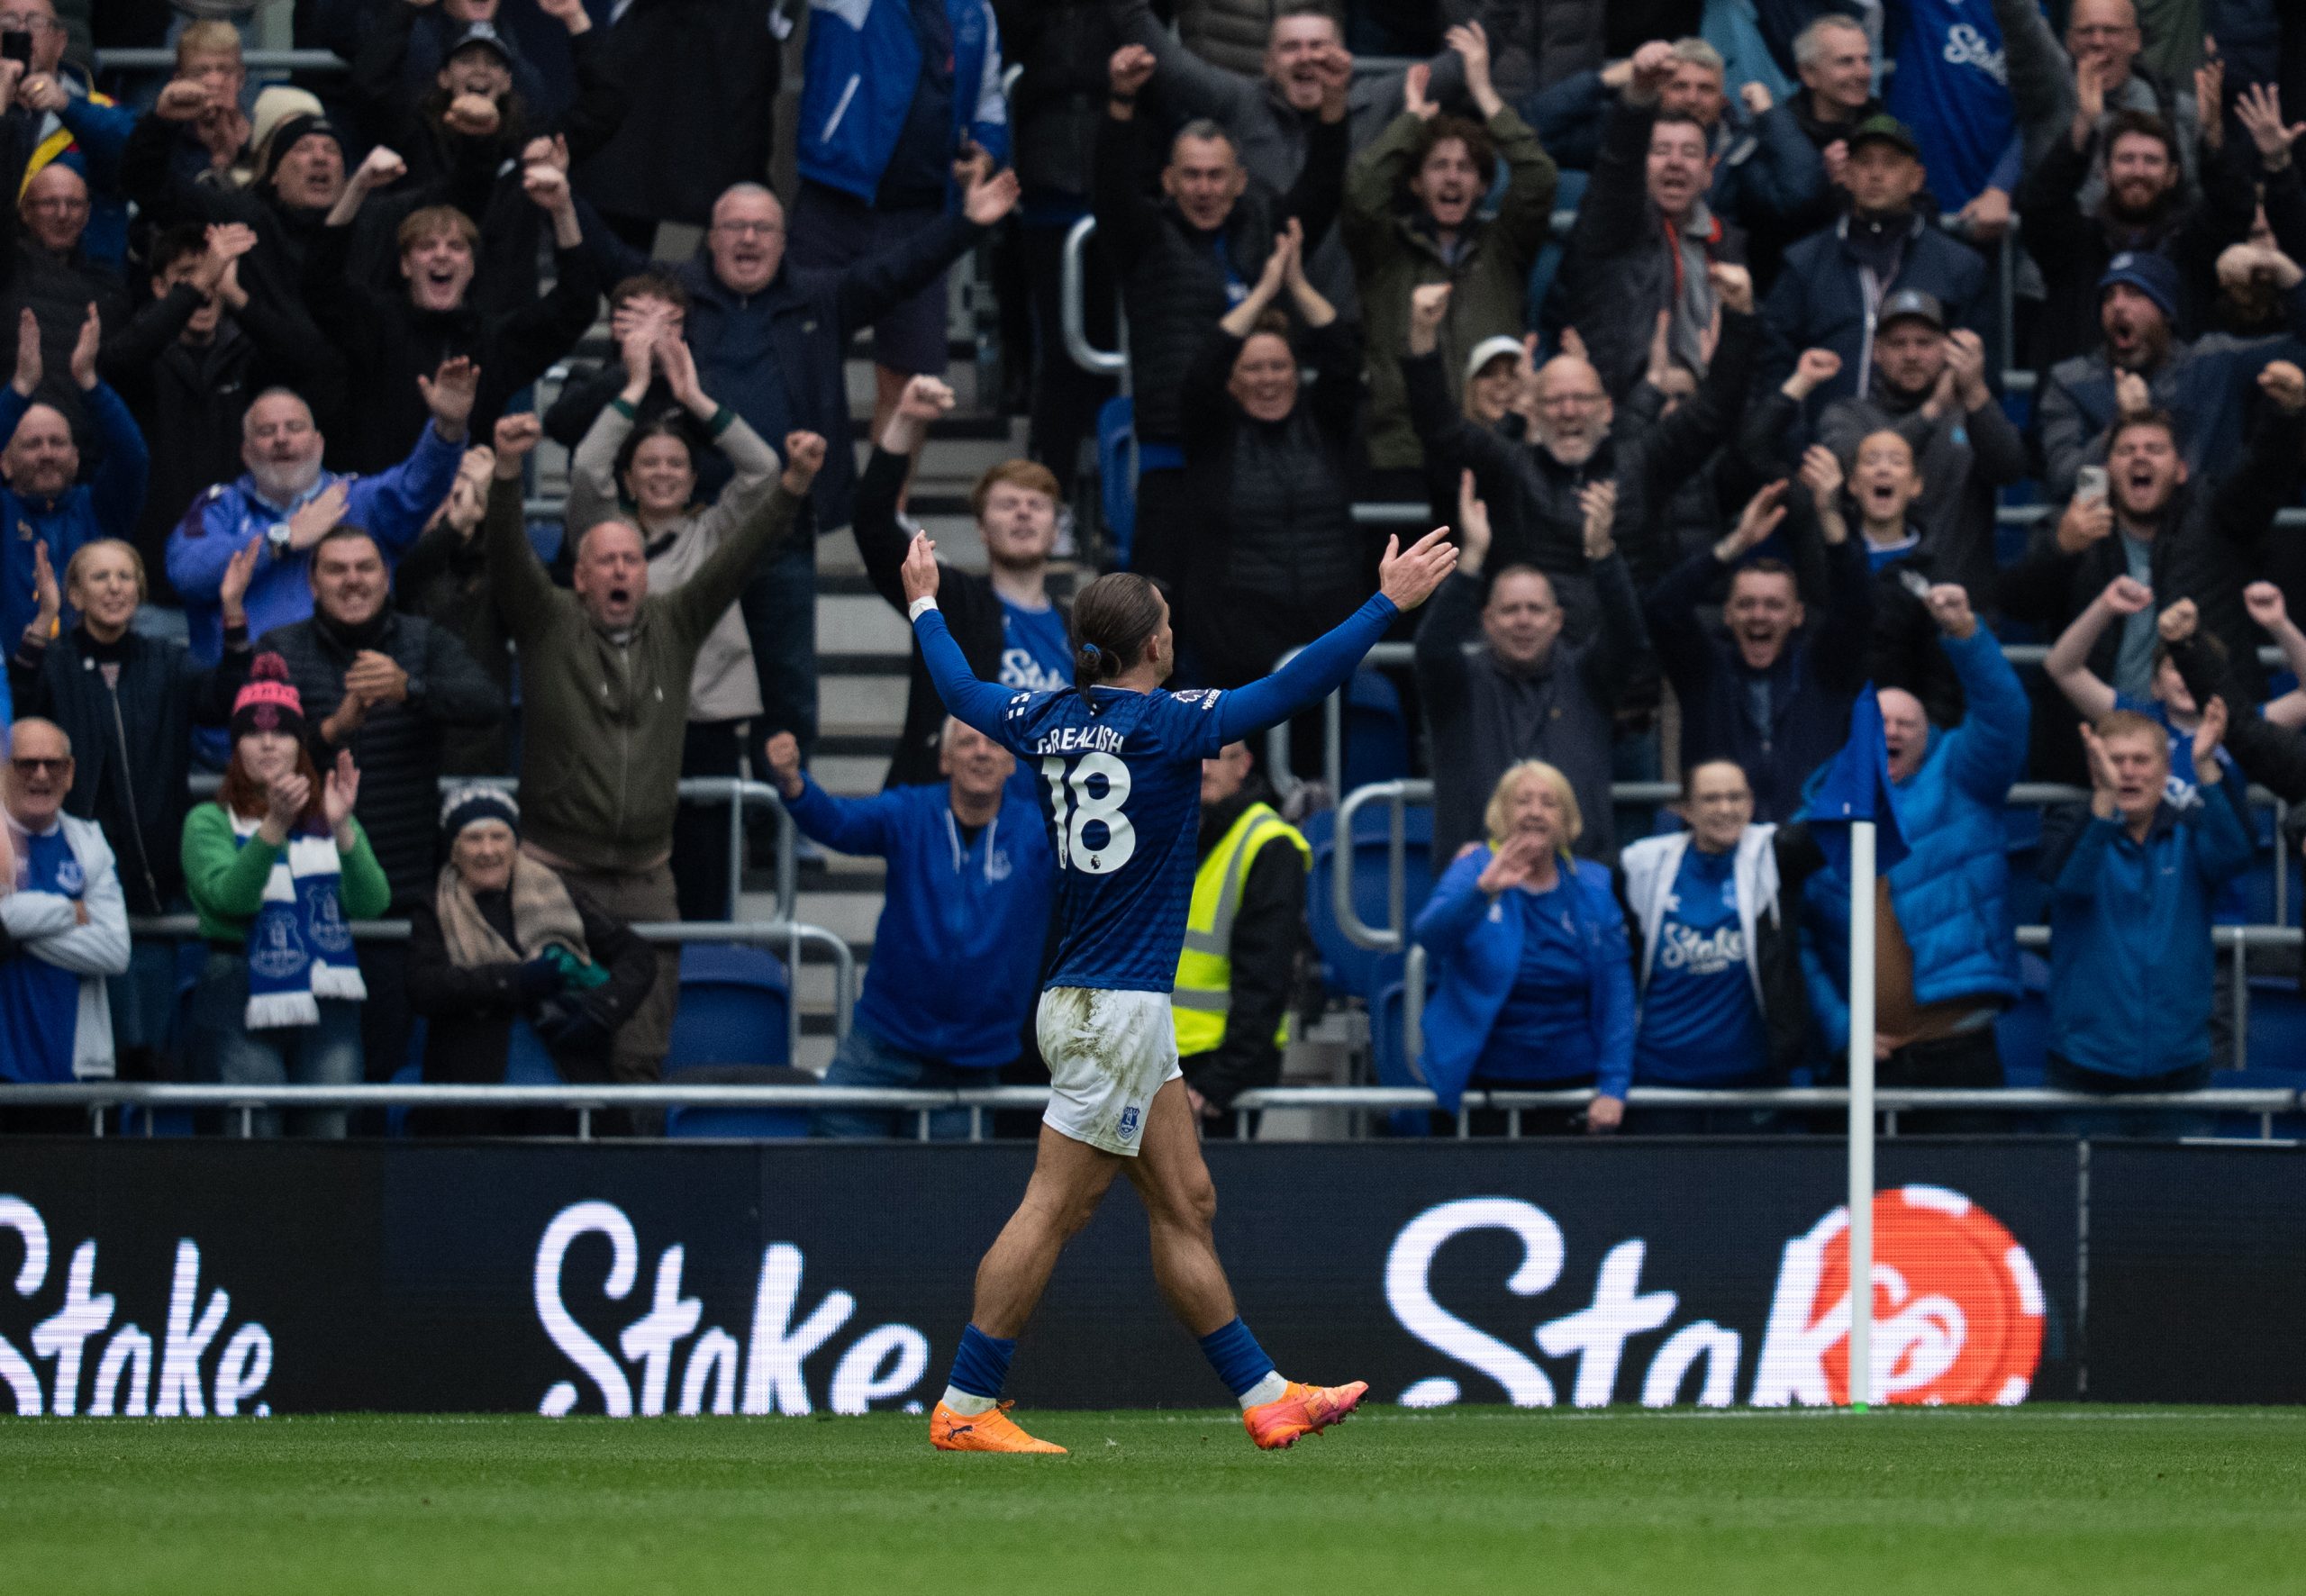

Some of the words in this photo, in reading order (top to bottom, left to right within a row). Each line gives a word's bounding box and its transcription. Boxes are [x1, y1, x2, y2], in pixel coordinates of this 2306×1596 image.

[1037, 724, 1124, 755] GREALISH
[1041, 751, 1136, 875] 18
[534, 1200, 929, 1417] Stake
